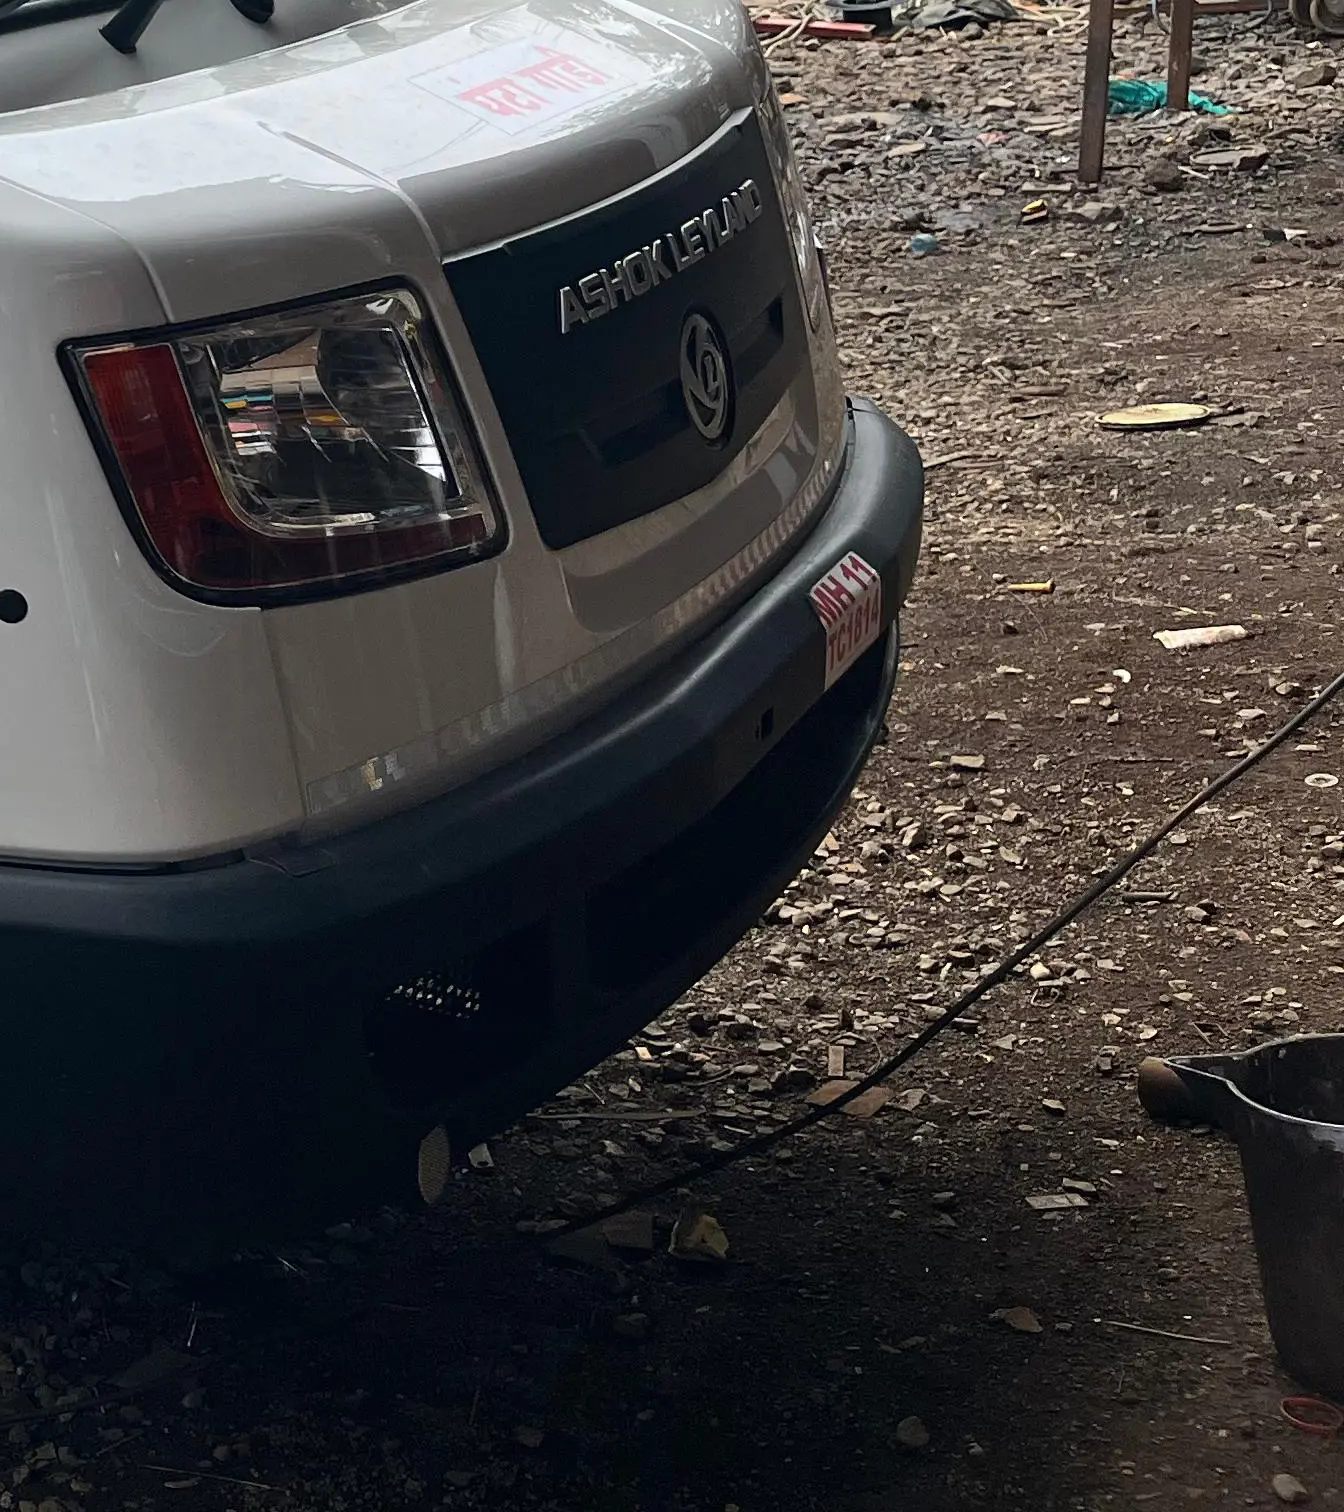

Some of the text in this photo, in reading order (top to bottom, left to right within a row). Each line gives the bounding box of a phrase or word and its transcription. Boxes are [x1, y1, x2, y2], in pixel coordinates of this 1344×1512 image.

[558, 178, 763, 335] ASHOK LEYLAND
[813, 554, 878, 629] MH 11
